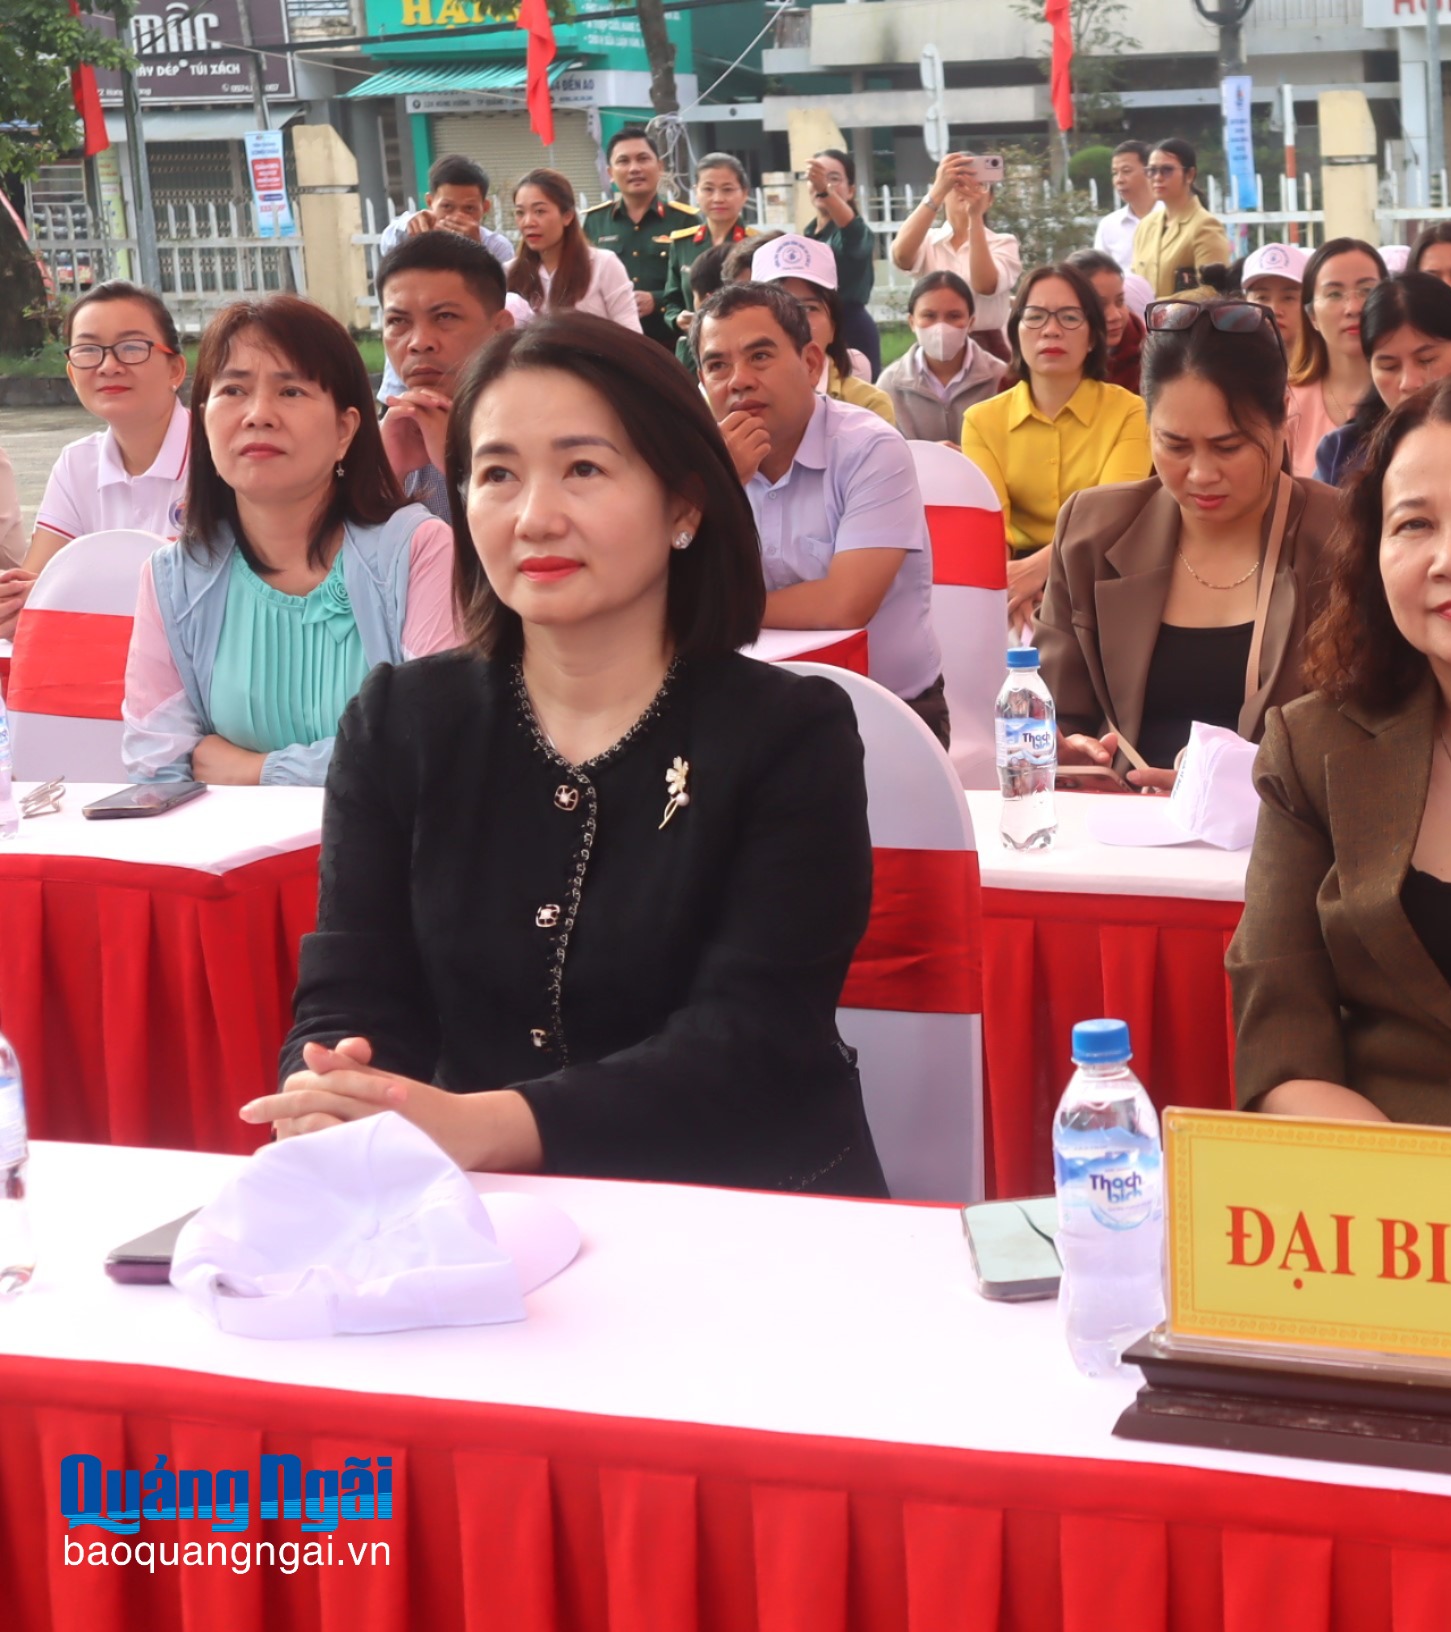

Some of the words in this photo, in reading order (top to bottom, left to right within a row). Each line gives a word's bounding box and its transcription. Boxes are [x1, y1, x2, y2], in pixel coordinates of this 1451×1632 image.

[156, 62, 180, 76] DÉP
[190, 61, 208, 75] TÚI
[210, 60, 240, 74] XÁCH
[1225, 1205, 1356, 1290] ĐẠI
